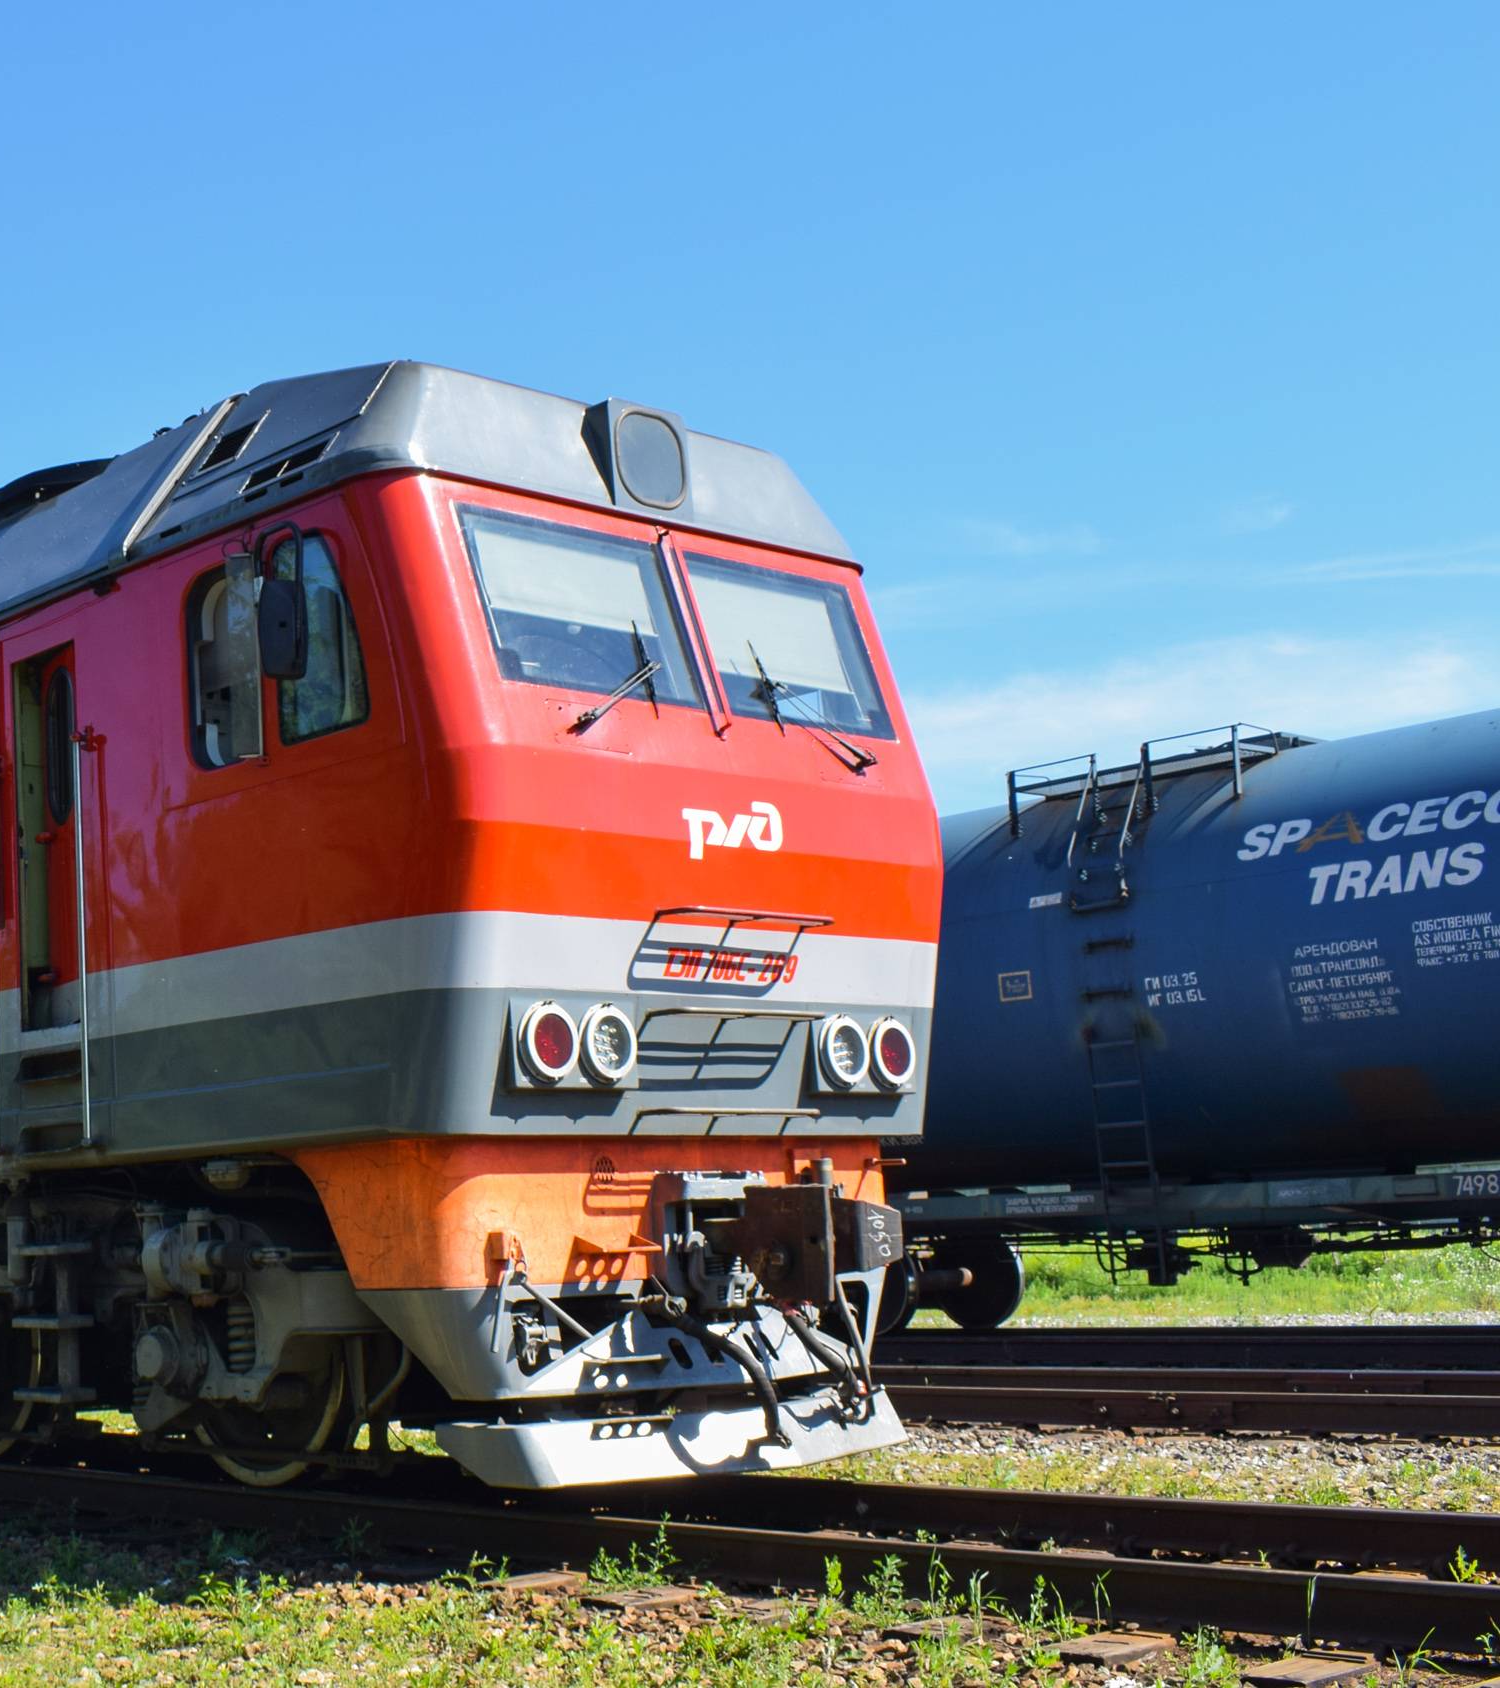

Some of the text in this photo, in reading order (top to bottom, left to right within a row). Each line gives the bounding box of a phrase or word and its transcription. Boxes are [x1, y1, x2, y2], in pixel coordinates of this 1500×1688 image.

[1309, 842, 1485, 906] TRANS
[1412, 911, 1492, 933] СОБСТВЕННИК
[1414, 933, 1431, 946] AS
[1433, 927, 1480, 944] NORDEA
[1293, 937, 1379, 959] АРЕНДОВАН
[1451, 1174, 1499, 1196] 7498
